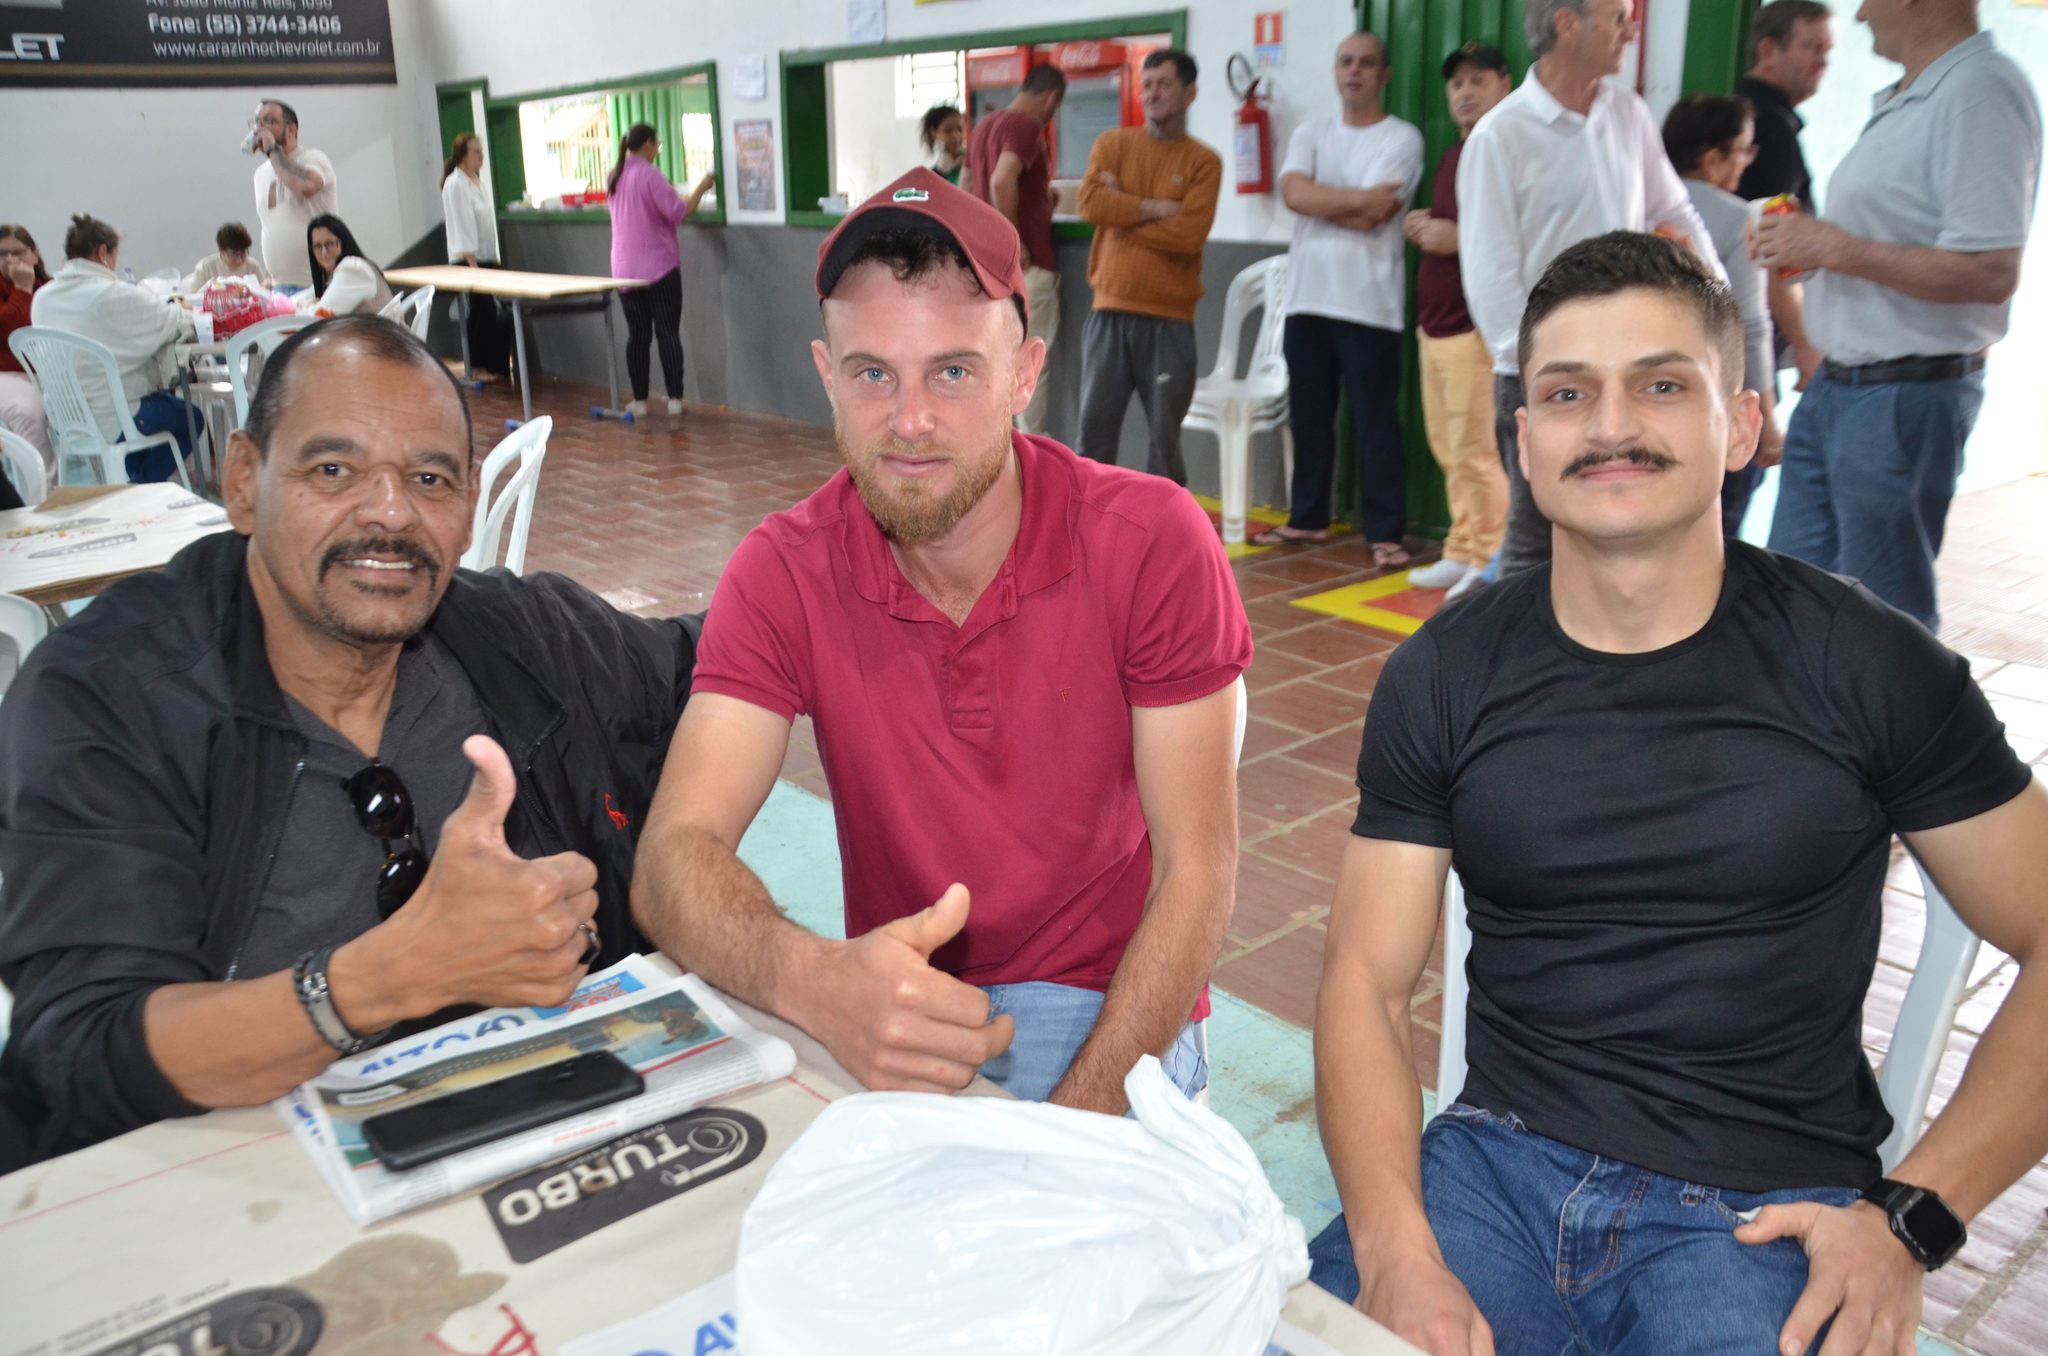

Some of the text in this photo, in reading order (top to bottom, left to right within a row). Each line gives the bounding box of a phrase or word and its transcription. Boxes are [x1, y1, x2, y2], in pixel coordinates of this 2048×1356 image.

[148, 12, 342, 37] Fone: (55) 3744-3406
[153, 38, 381, 58] www.carazinhochevrolet.com.br
[498, 1132, 690, 1227] TURBO
